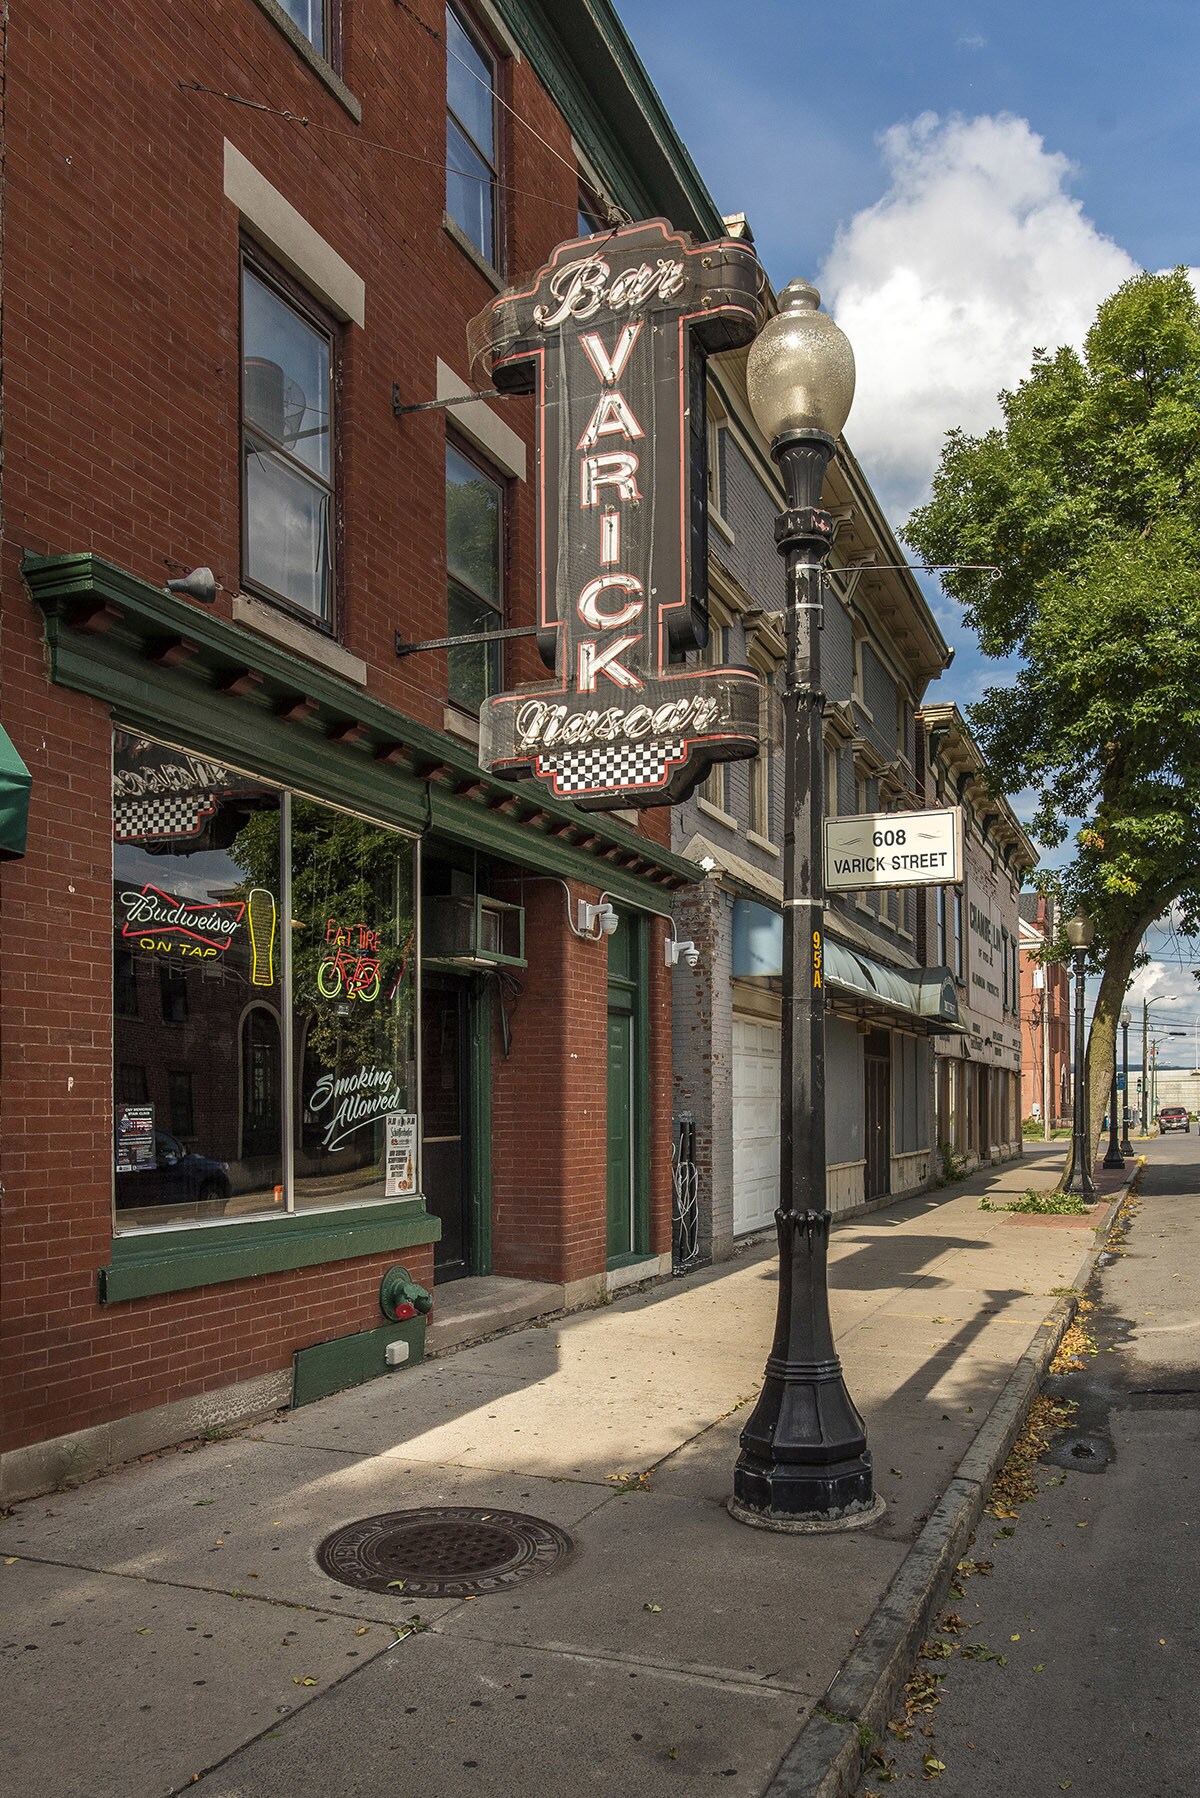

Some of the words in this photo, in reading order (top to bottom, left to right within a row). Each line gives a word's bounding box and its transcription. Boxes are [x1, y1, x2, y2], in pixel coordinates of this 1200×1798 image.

[533, 253, 684, 327] Bar
[575, 320, 645, 693] VARICK
[516, 695, 719, 749] Nascar
[872, 829, 906, 847] 608
[834, 857, 886, 874] VARICK
[892, 852, 947, 870] STREET
[120, 891, 241, 934] Budweiser
[326, 918, 353, 947] FAT
[354, 923, 381, 952] TIRE
[140, 938, 171, 952] ON
[180, 943, 217, 957] TAP
[812, 931, 822, 988] 95A
[310, 1065, 393, 1112] Smoking
[321, 1086, 400, 1146] Allowed
